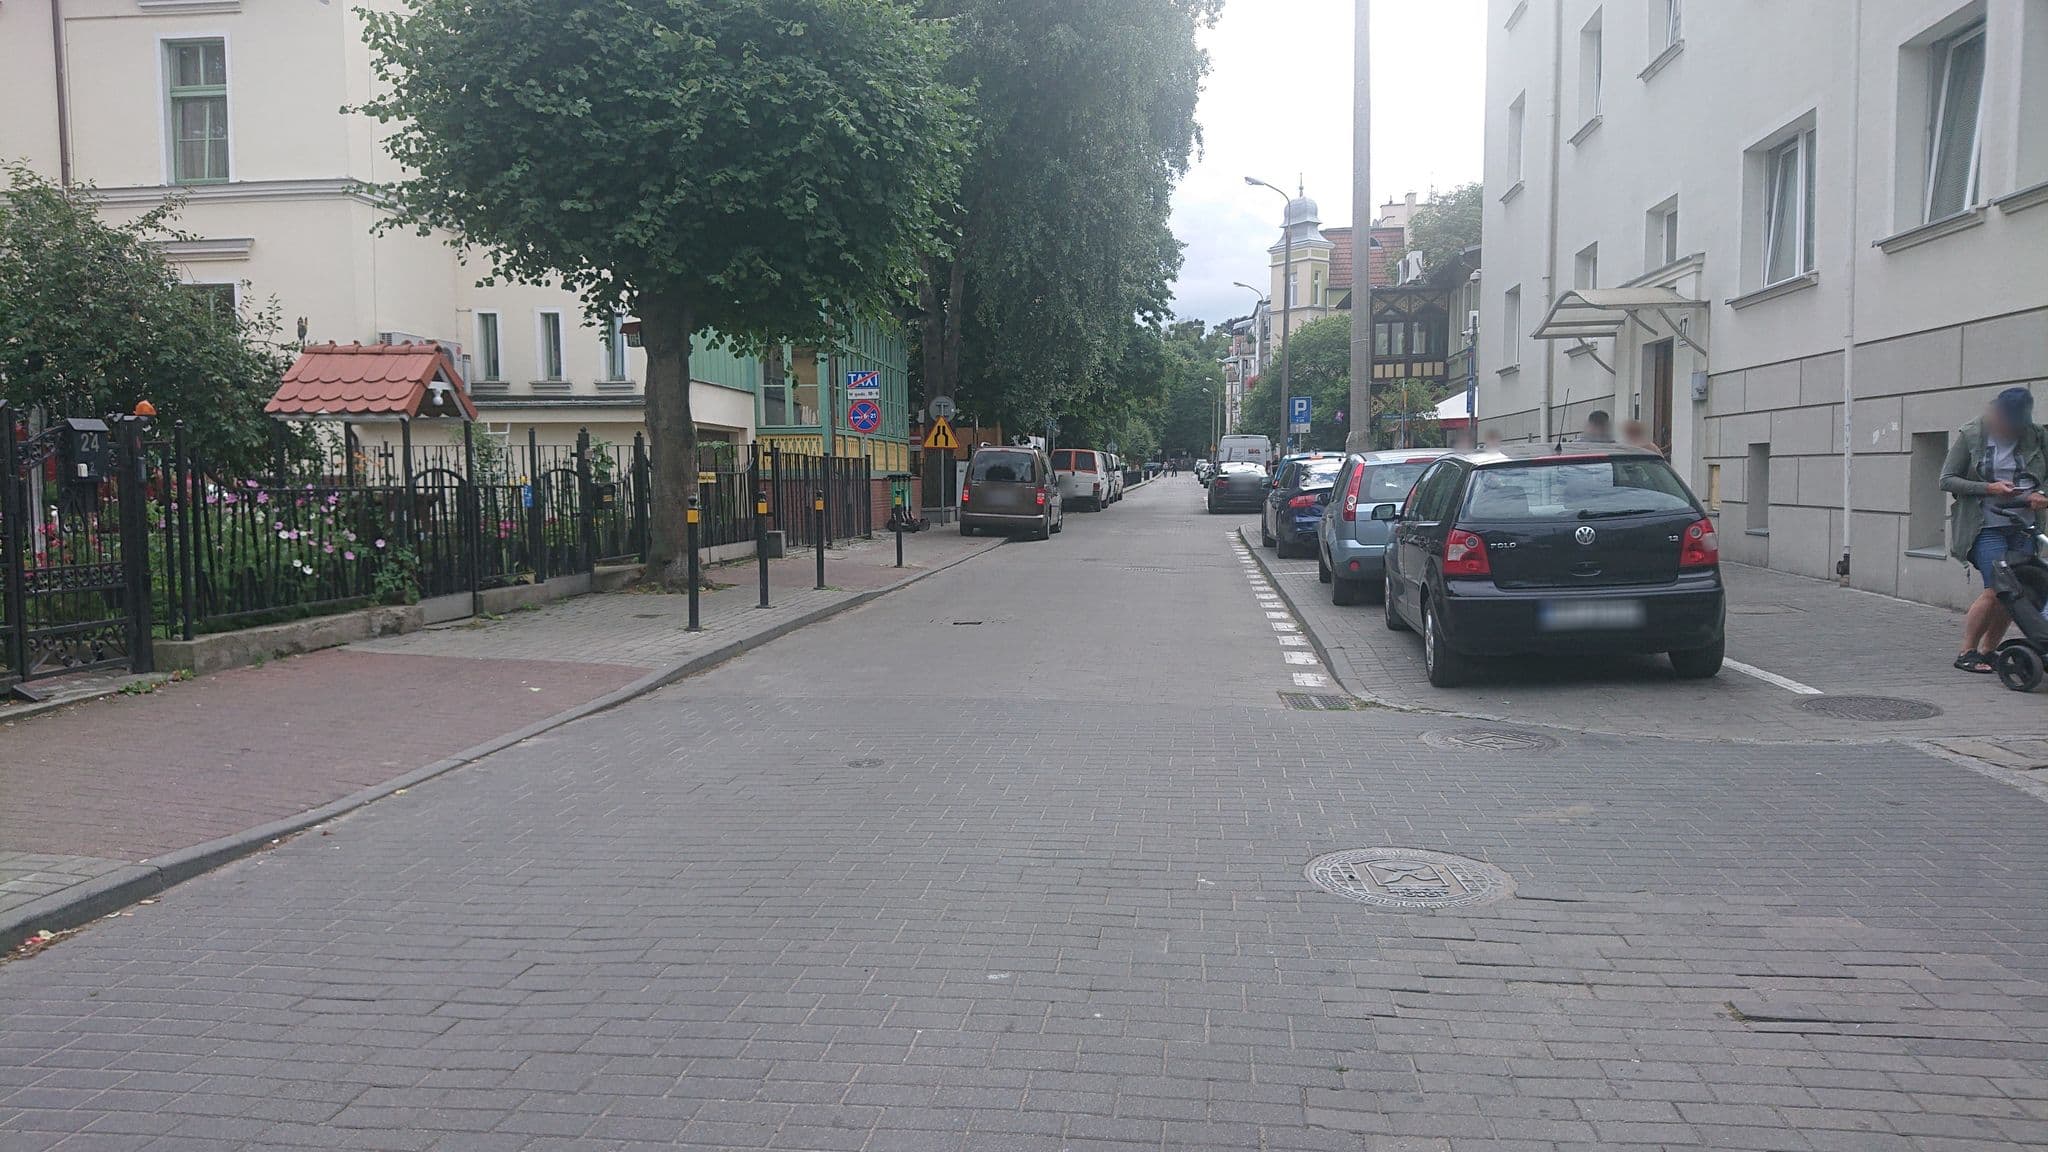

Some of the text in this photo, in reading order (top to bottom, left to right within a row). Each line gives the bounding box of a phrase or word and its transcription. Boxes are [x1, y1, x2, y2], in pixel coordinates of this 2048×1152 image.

[848, 373, 878, 386] TAXI
[1294, 399, 1307, 416] P
[81, 433, 100, 452] 24
